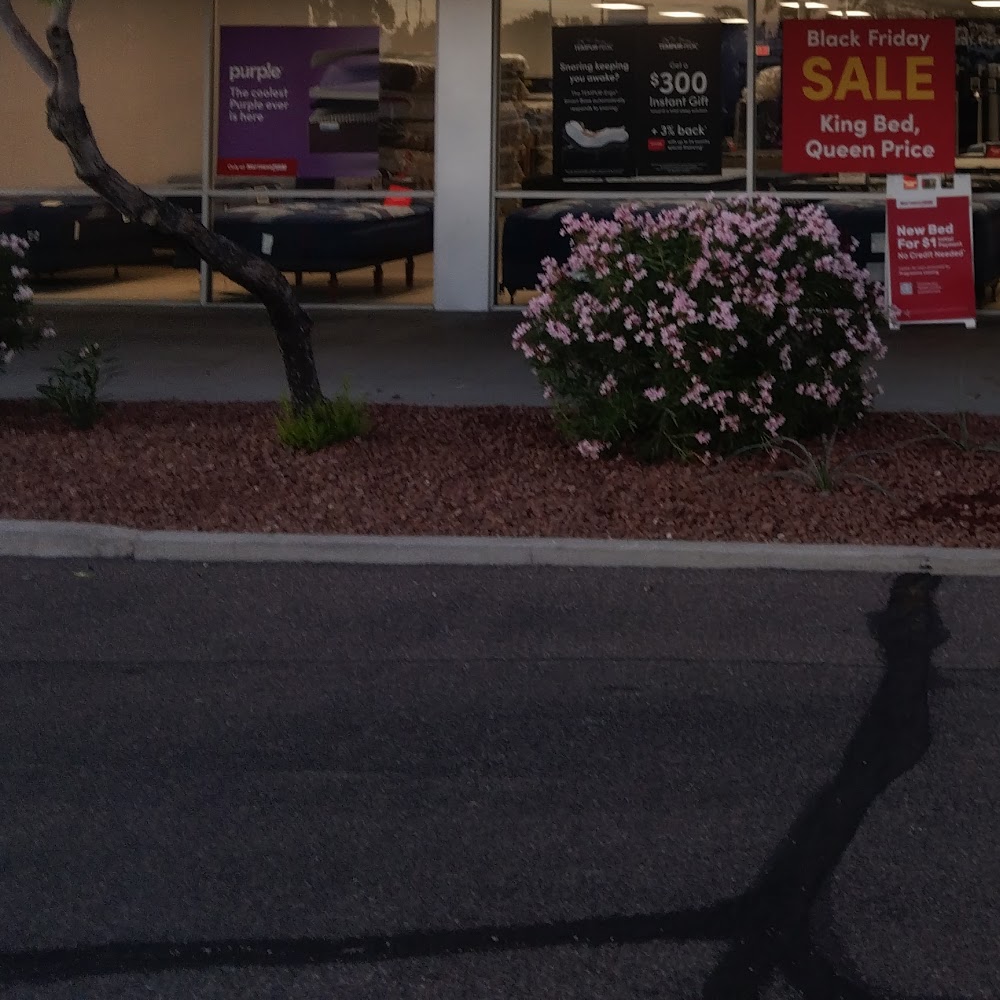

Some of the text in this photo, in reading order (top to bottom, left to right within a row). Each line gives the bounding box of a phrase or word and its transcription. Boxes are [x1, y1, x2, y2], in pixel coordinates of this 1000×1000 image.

[807, 29, 931, 51] Black Friday
[229, 62, 282, 82] purple
[560, 61, 629, 73] Snoring keeping
[570, 73, 620, 85] you awake?
[649, 71, 708, 95] $300
[802, 56, 935, 101] SALE
[230, 87, 249, 97] The
[230, 99, 264, 112] Purple
[649, 95, 709, 107] Instant Gift
[240, 110, 264, 121] here
[661, 125, 675, 136] 3%
[820, 113, 920, 138] King Bed,
[805, 139, 936, 160] Queen Price
[897, 223, 954, 236] New Bed
[897, 237, 936, 249] For $1
[897, 251, 908, 260] No
[910, 250, 934, 259] Credit
